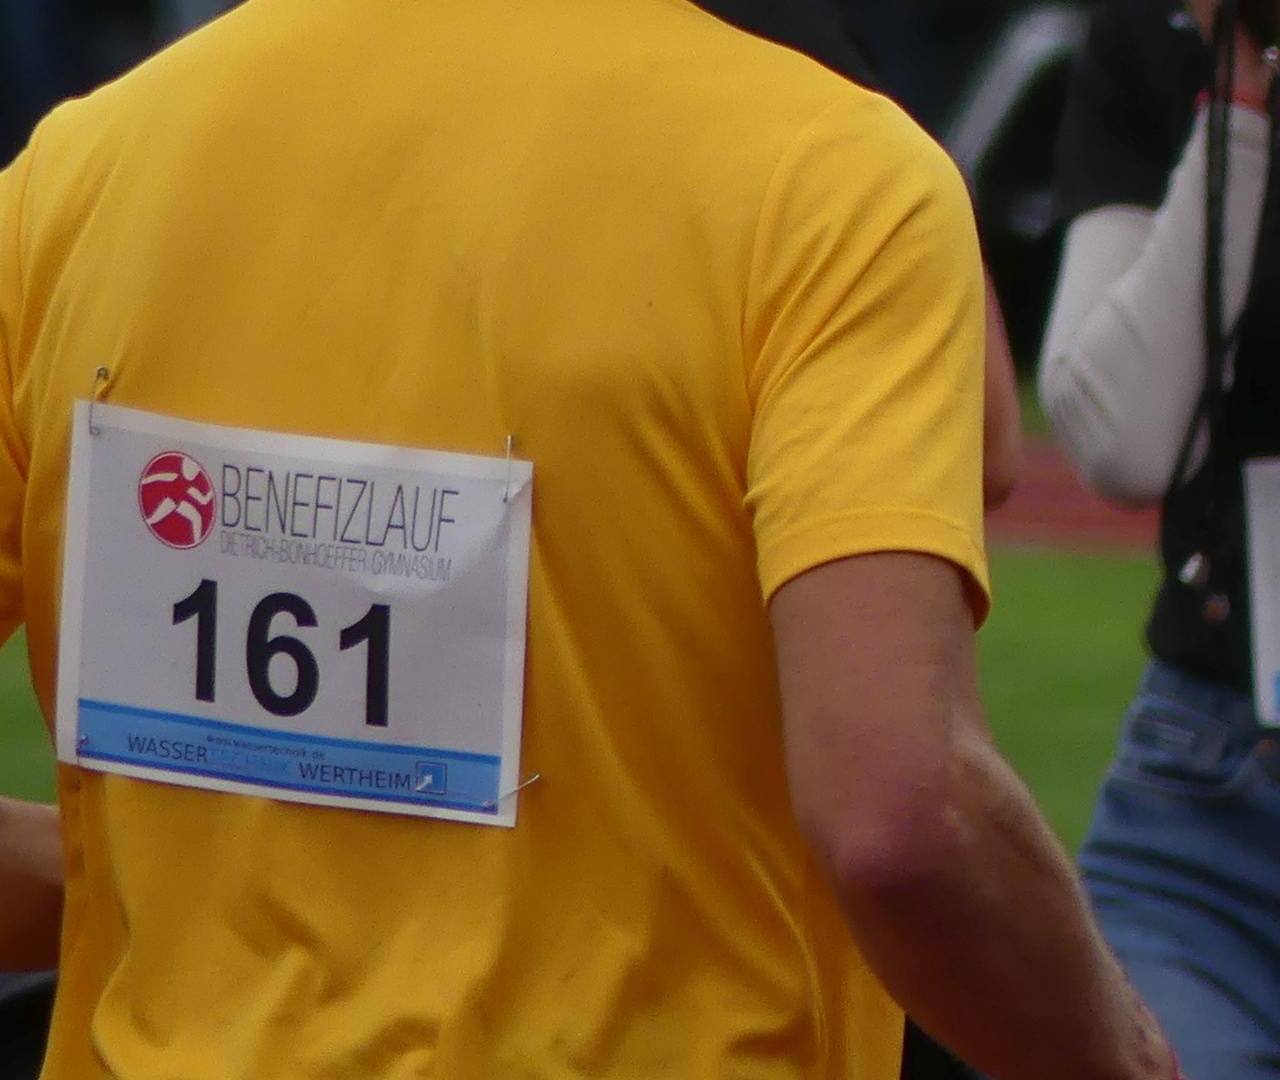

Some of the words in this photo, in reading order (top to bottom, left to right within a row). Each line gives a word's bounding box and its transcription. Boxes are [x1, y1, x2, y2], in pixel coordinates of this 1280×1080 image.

[220, 463, 460, 554] BENEFIZLAUF
[172, 578, 392, 728] 161
[127, 733, 208, 765] WASSER
[298, 761, 411, 792] WERTHEIM
